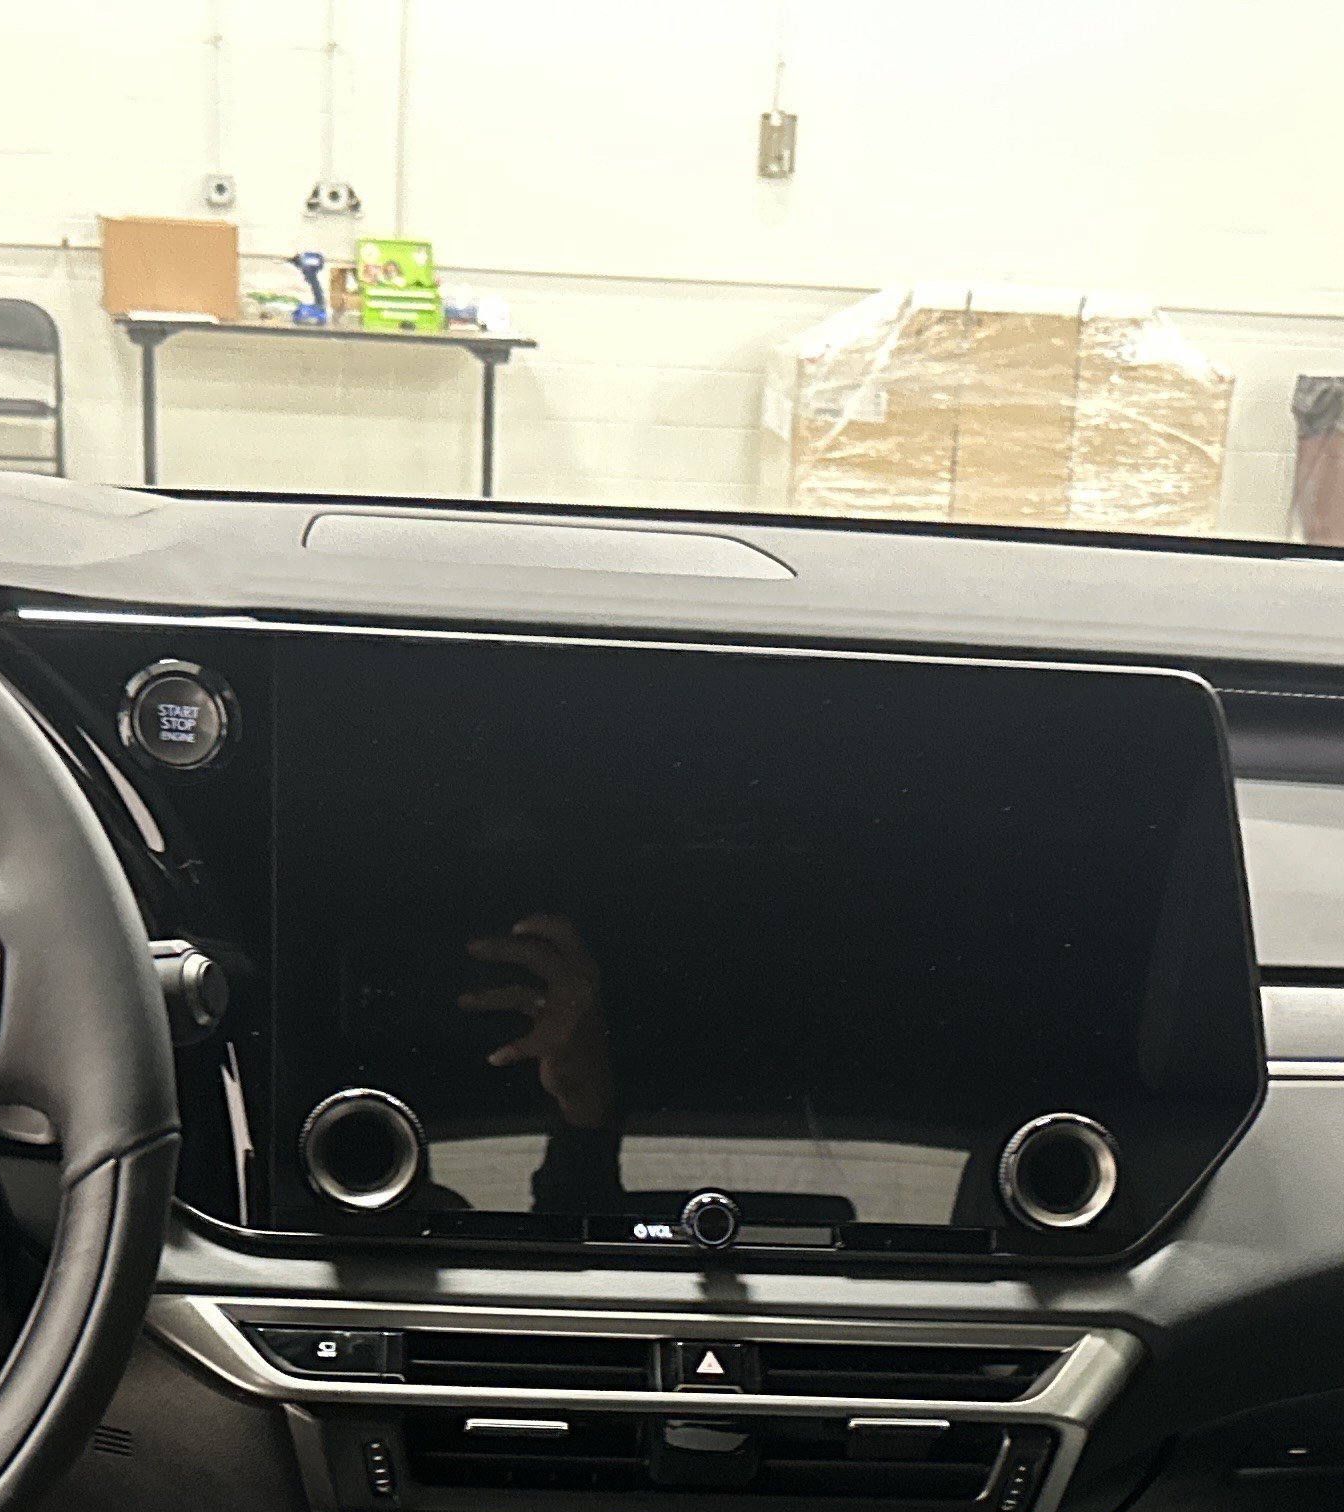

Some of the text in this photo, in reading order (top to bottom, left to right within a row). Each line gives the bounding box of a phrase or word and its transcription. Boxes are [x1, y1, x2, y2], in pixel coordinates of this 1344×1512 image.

[158, 703, 199, 718] START
[159, 717, 197, 731] STOP
[646, 1225, 673, 1238] VOL
